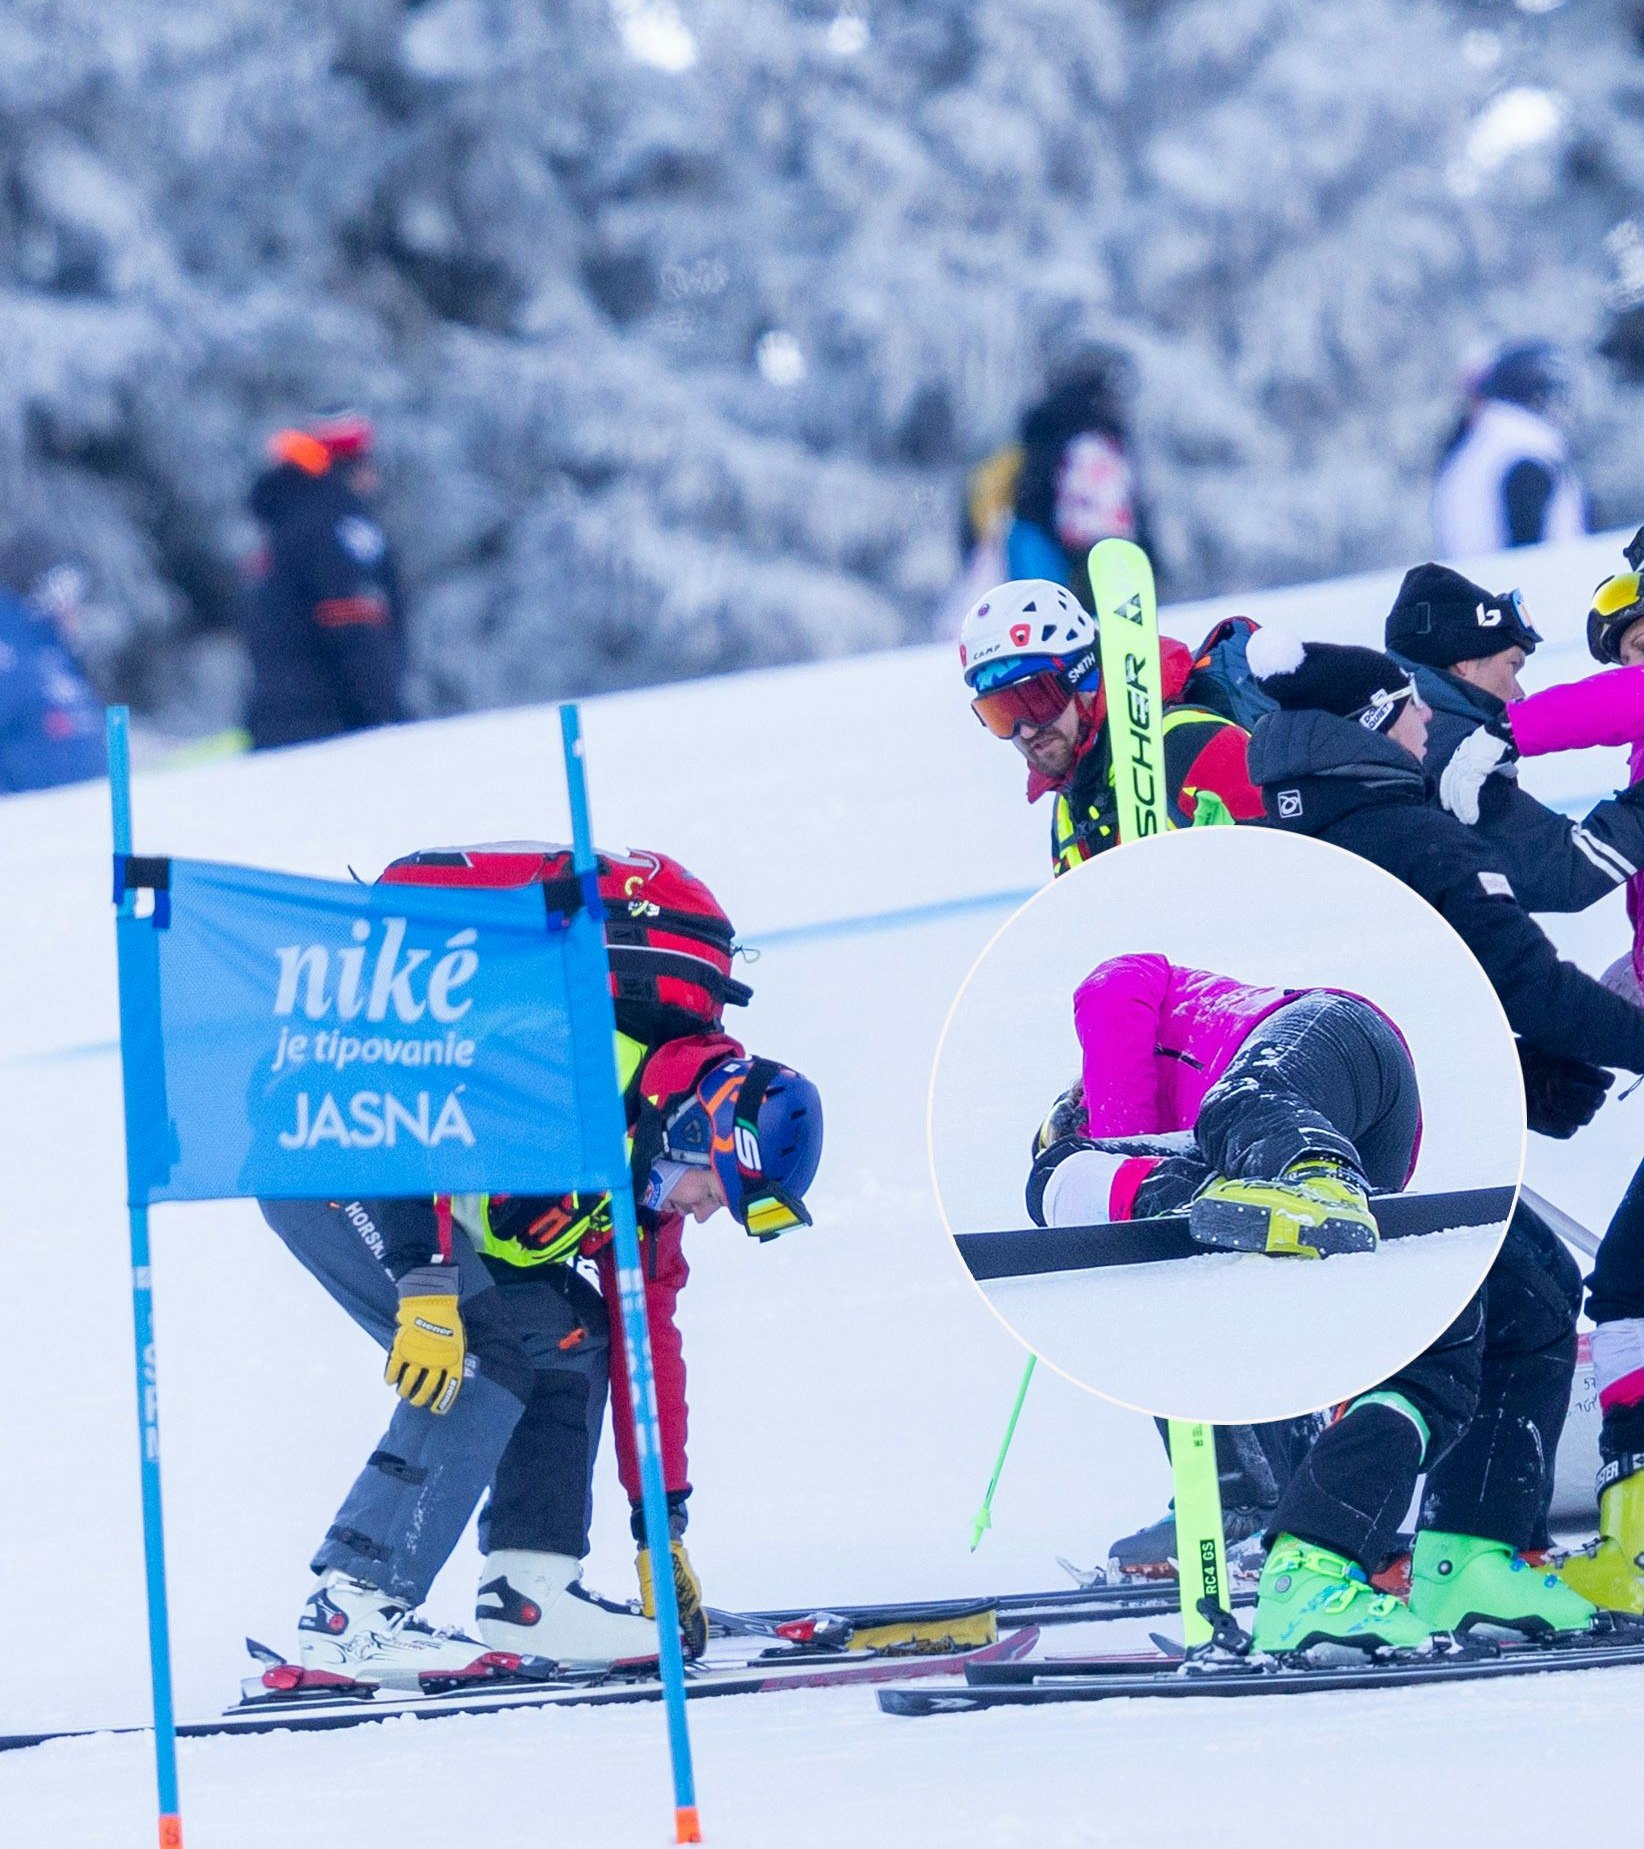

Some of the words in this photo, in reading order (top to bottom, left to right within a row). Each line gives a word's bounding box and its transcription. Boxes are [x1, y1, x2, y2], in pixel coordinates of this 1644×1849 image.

[973, 644, 1001, 660] CAMP
[1068, 651, 1096, 684] SMITH
[273, 916, 479, 1024] niké
[271, 1025, 309, 1073] je
[314, 1028, 476, 1073] tipovanie
[278, 1083, 477, 1150] JASNÁ
[1202, 1541, 1215, 1562] GS
[1205, 1566, 1217, 1595] RC4
